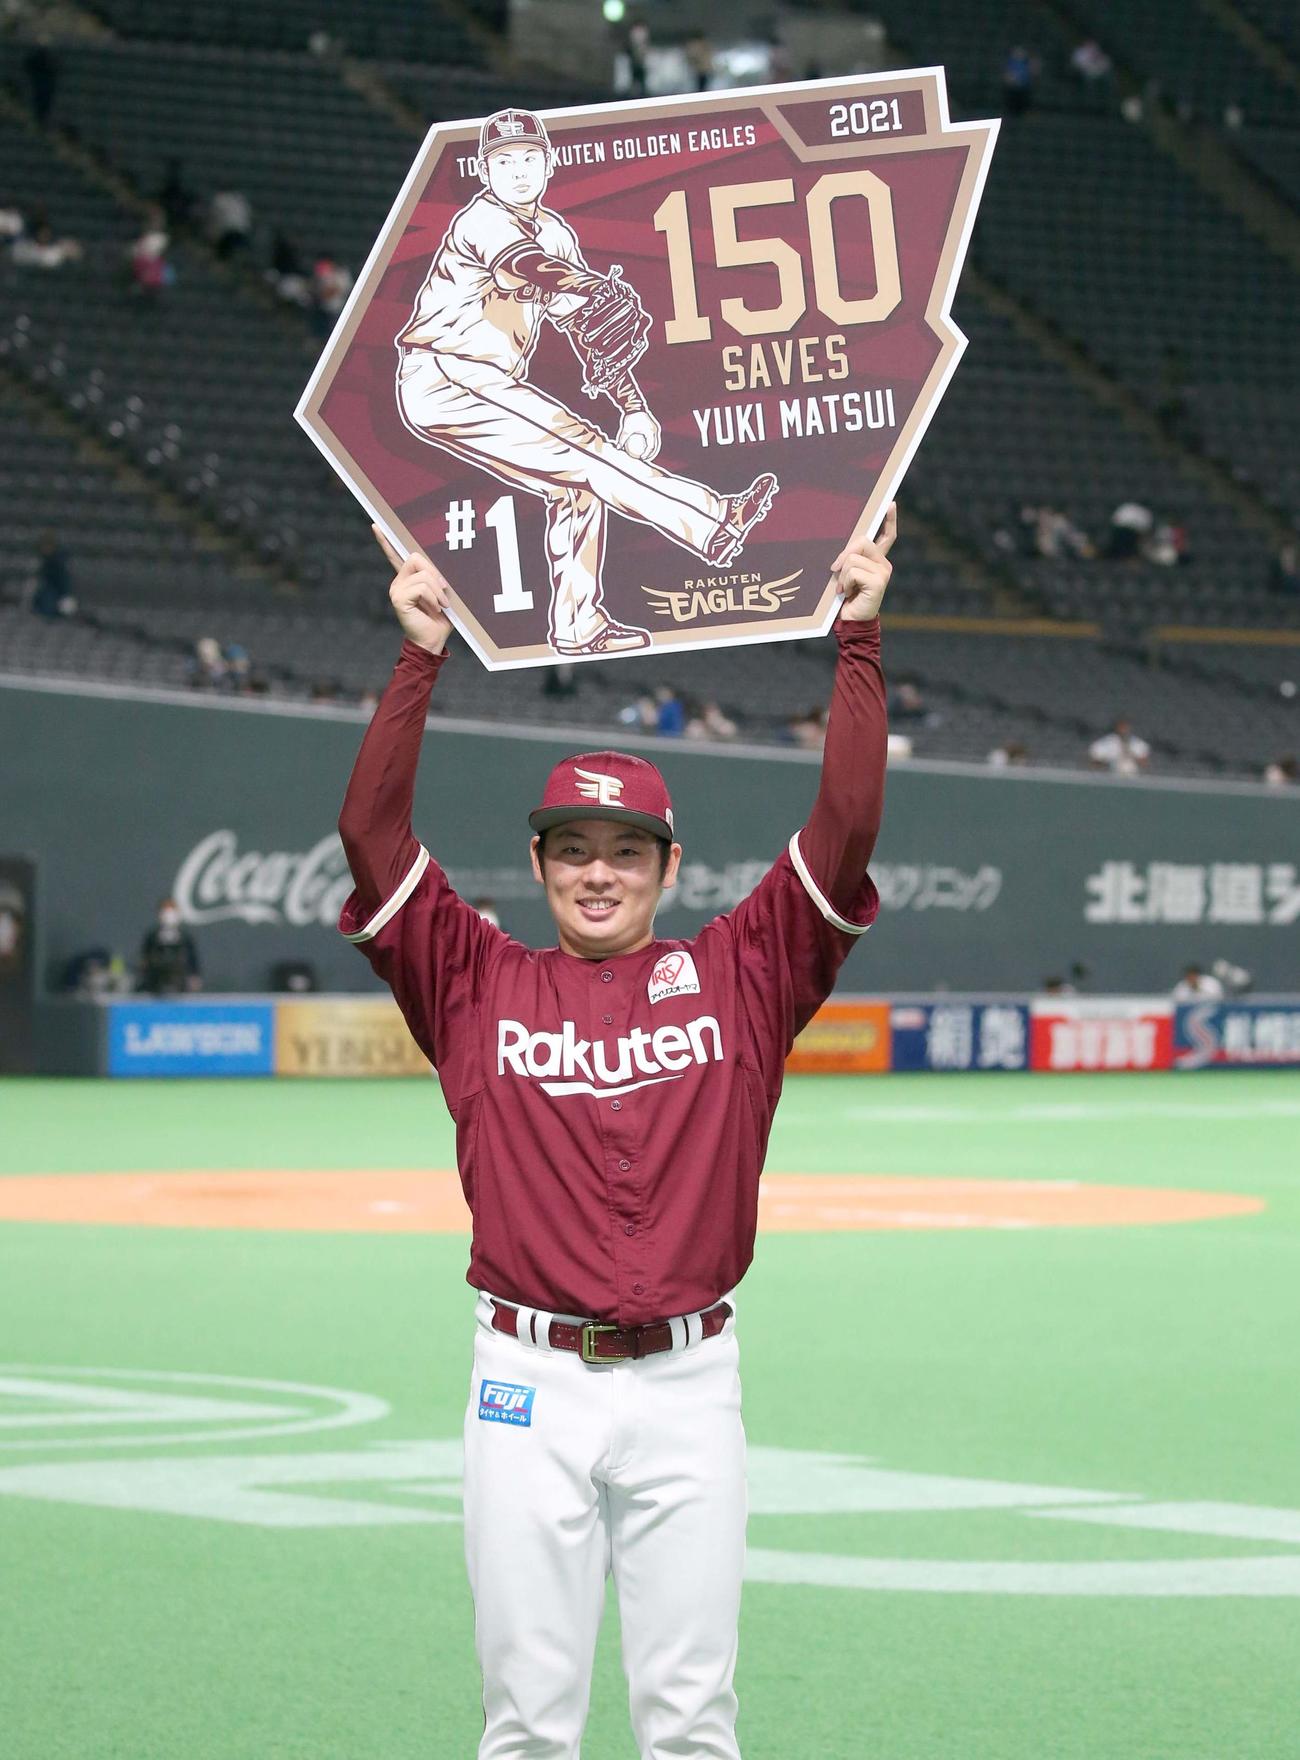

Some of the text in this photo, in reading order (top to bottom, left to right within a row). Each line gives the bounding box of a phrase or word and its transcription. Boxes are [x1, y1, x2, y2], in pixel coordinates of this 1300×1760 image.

[829, 98, 903, 137] 2021
[550, 124, 756, 168] KUTEN GOLDEN EAGLES
[653, 169, 902, 345] 150
[721, 334, 850, 392] SAVES
[692, 388, 897, 448] YUKI MATSUI
[444, 495, 534, 613] #1
[641, 572, 801, 622] EAGLES
[684, 572, 762, 590] RAKUTEN
[651, 964, 676, 985] IRIS
[496, 1014, 725, 1084] Rakuten
[483, 1383, 530, 1411] Fuji
